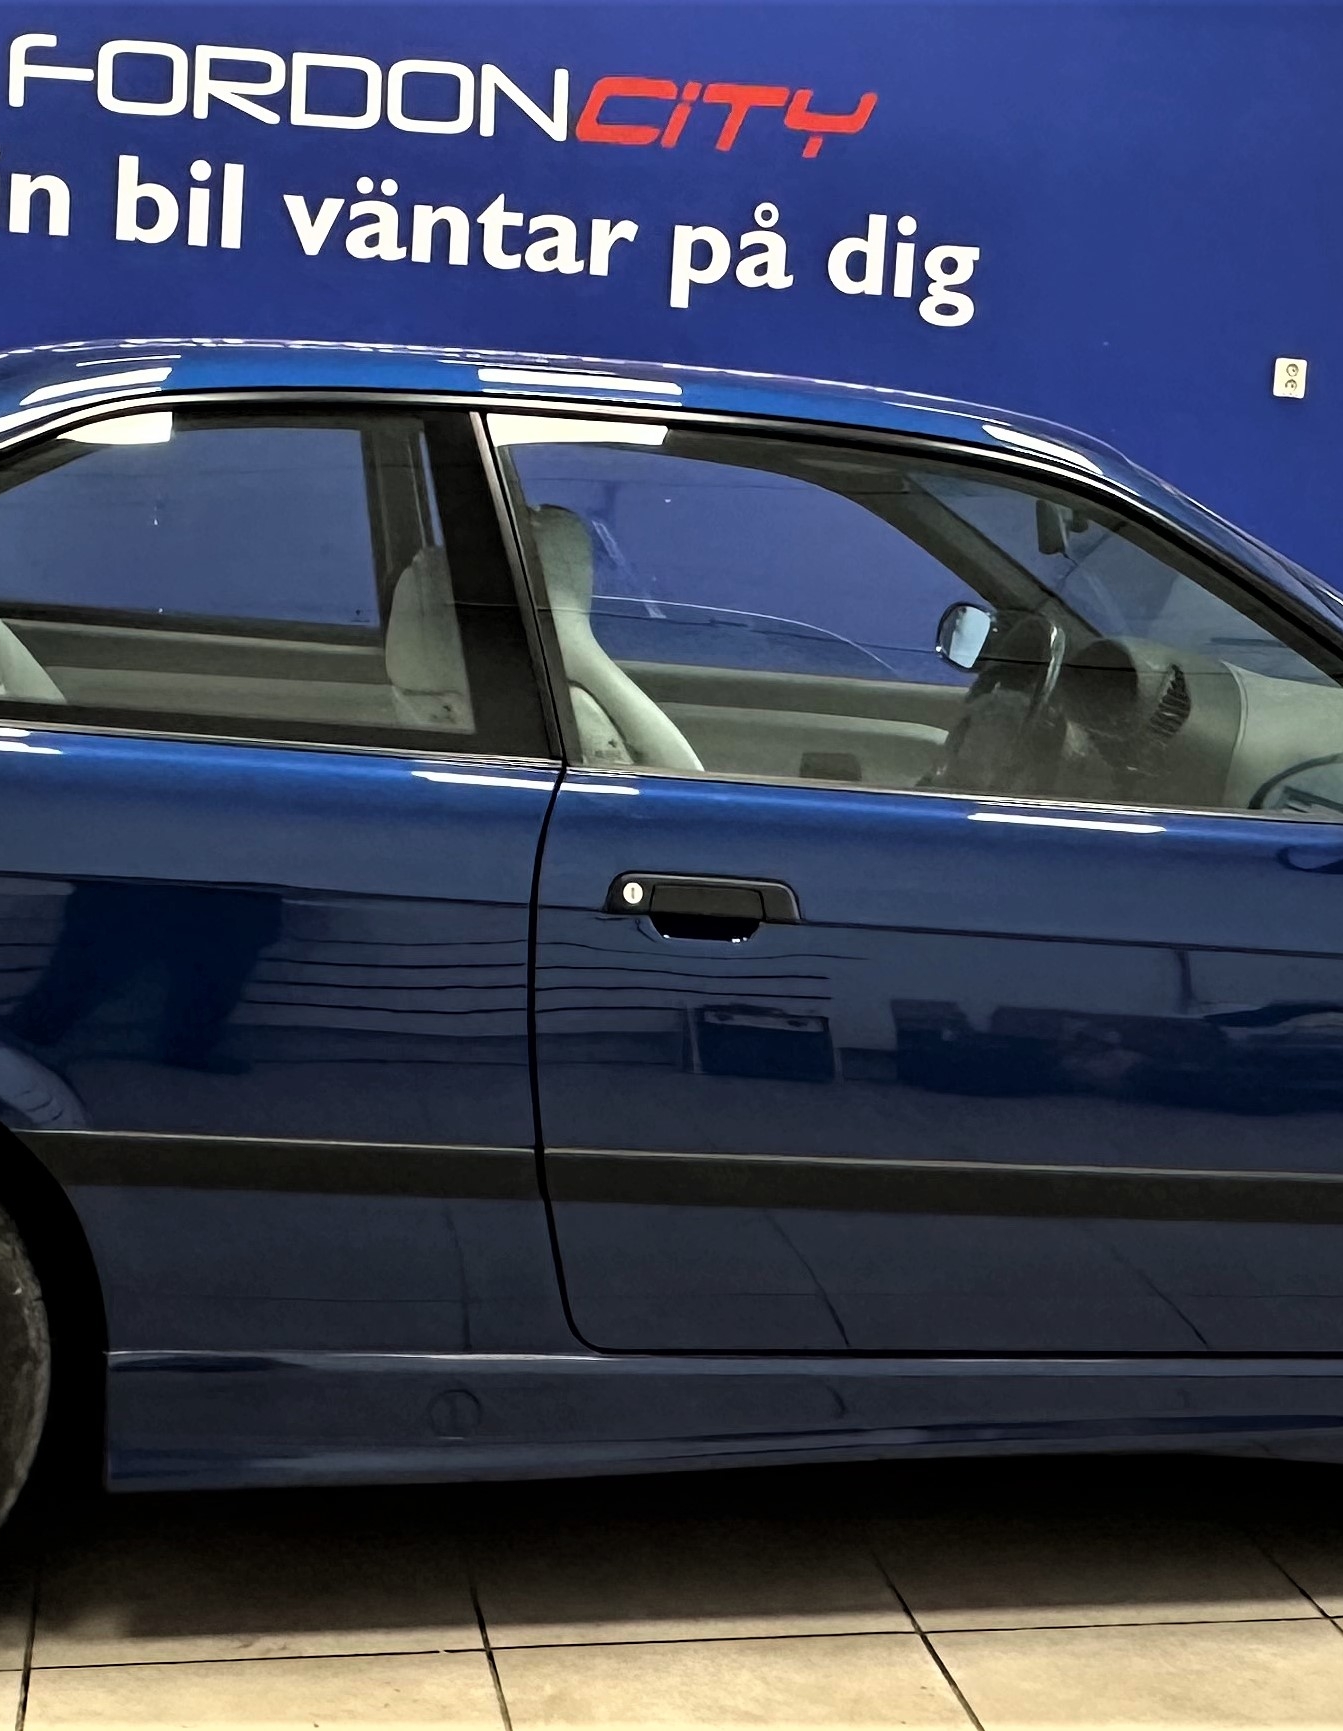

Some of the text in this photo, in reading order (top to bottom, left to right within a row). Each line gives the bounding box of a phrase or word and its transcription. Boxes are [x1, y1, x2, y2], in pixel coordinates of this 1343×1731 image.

[115, 154, 245, 250] bil
[282, 176, 639, 277] väntar
[669, 202, 794, 309] på
[827, 213, 980, 327] dig
